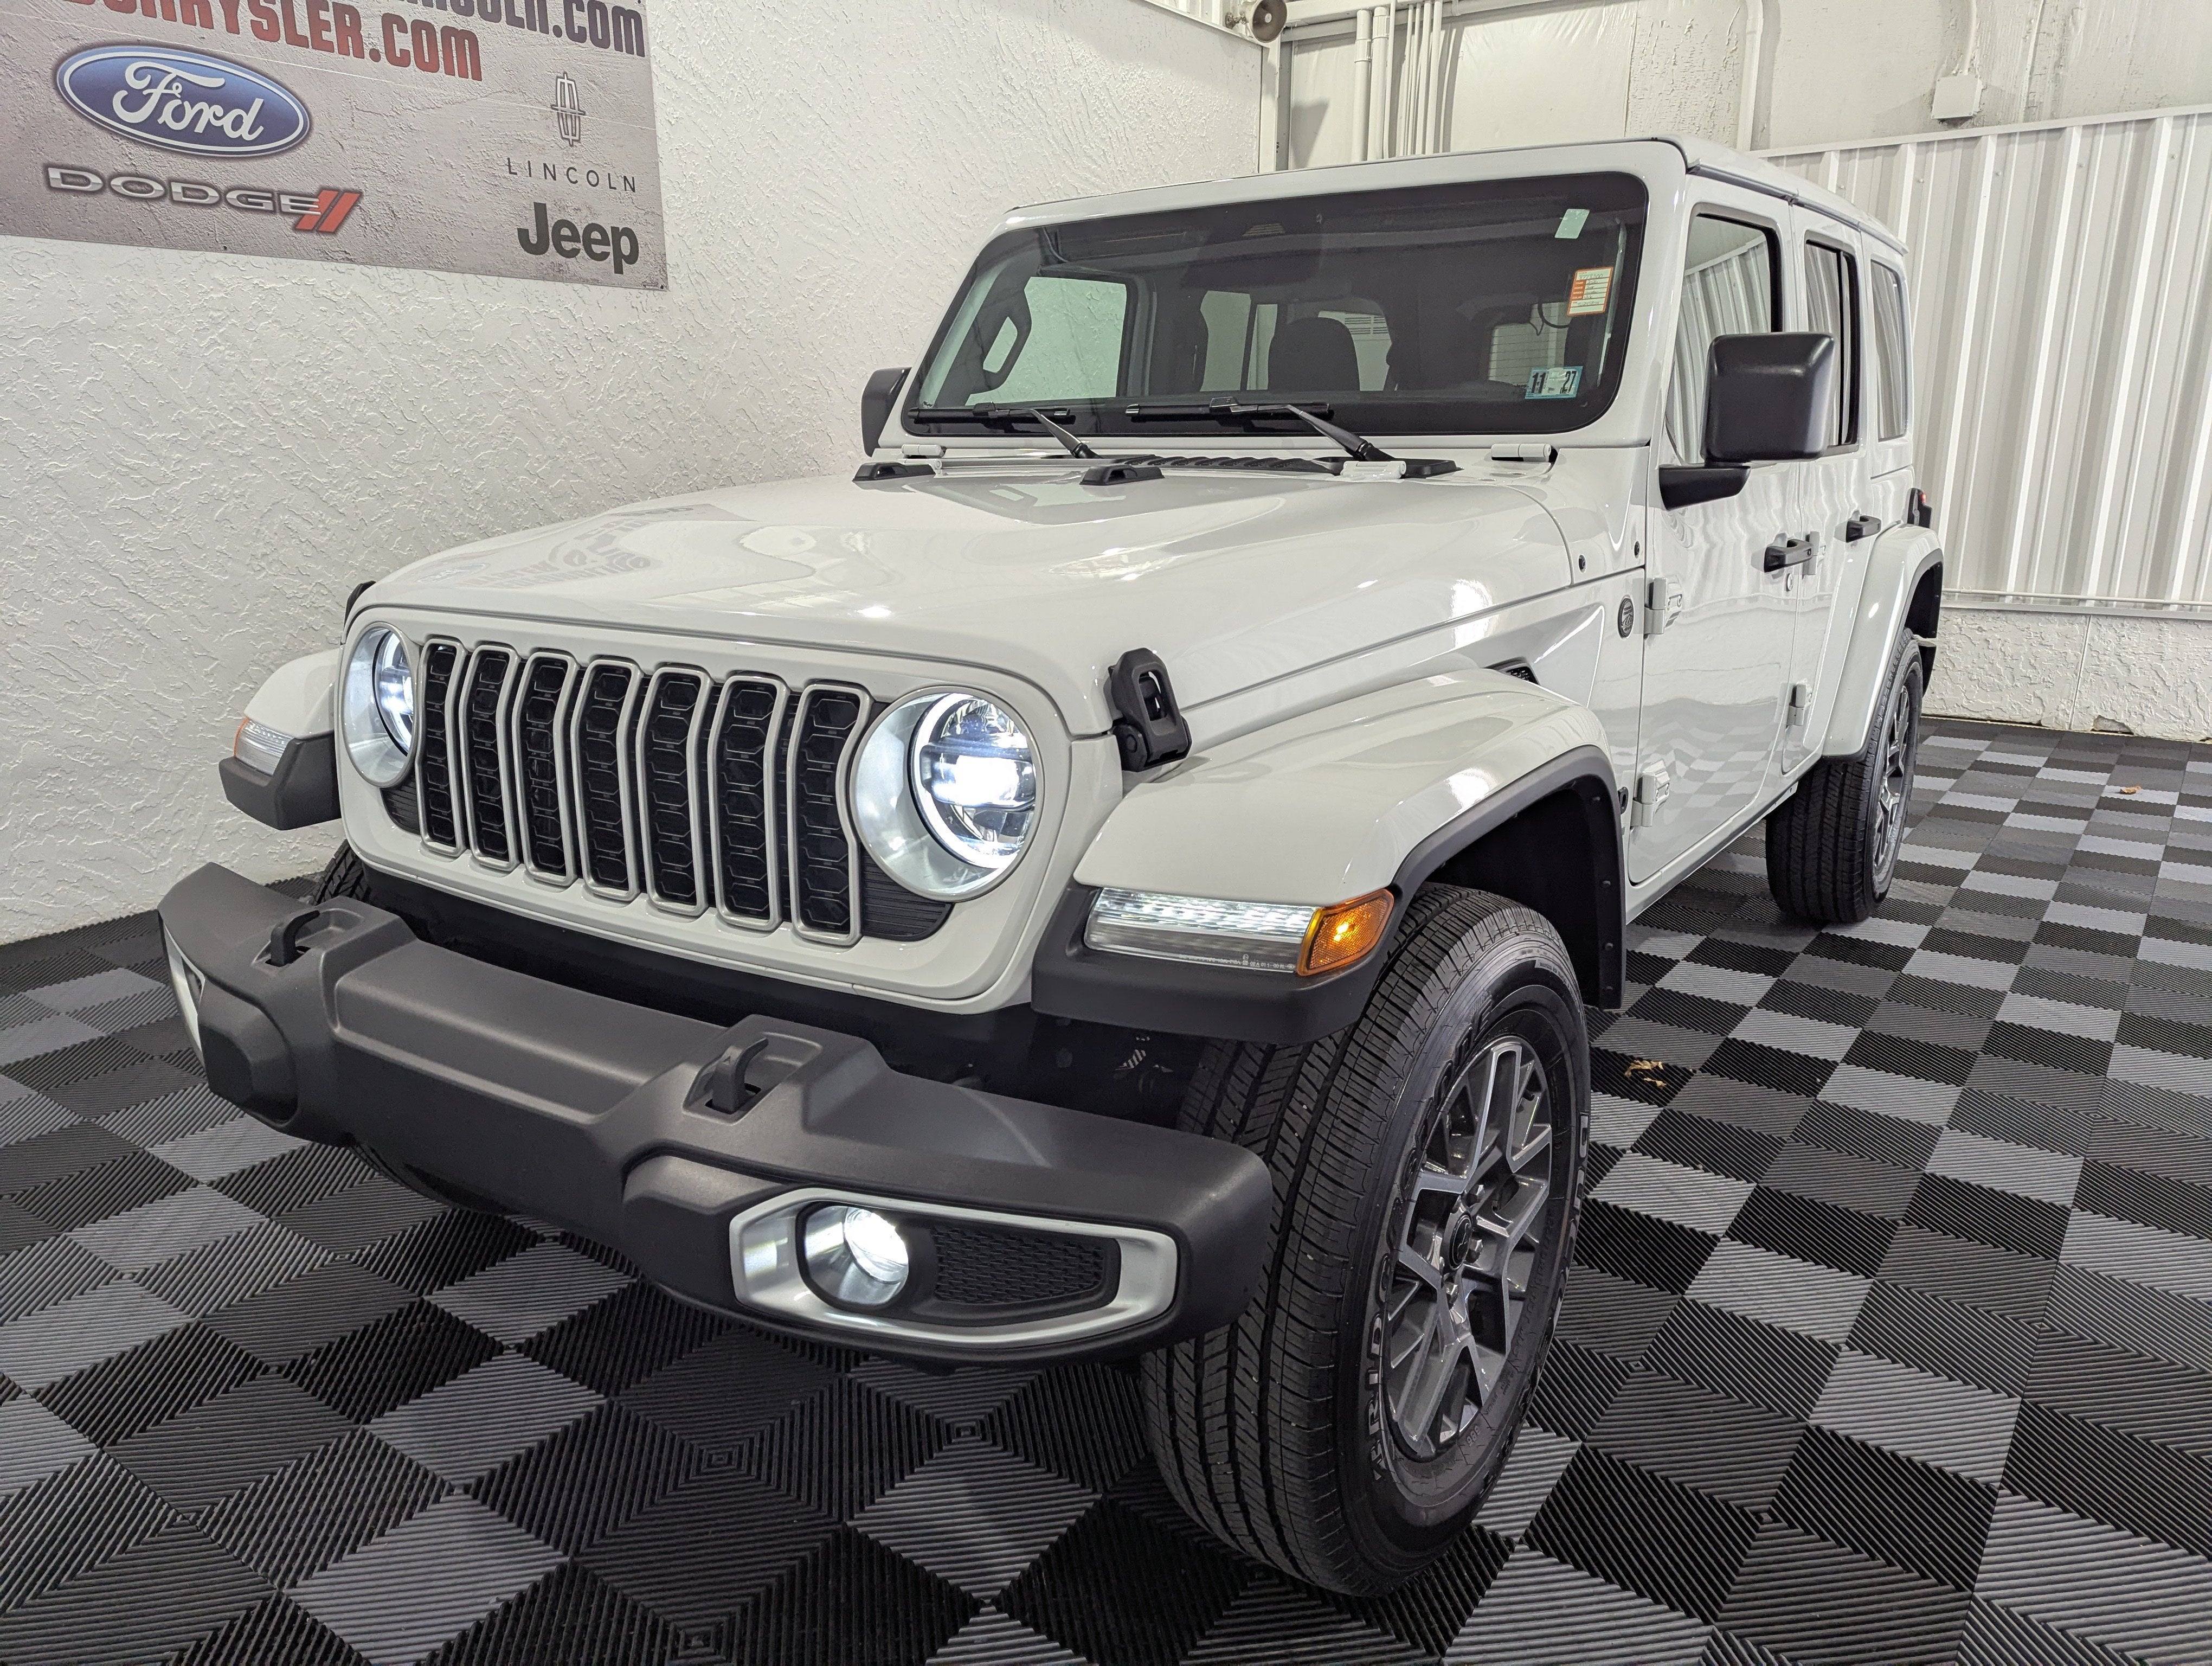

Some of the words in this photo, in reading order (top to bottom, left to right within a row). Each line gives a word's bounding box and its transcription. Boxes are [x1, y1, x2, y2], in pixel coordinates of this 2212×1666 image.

[112, 61, 264, 140] Ford
[47, 167, 321, 215] DODGE
[507, 157, 636, 193] LINCOLN
[517, 201, 639, 275] Jeep
[1531, 372, 1546, 394] 11
[1559, 370, 1577, 394] 27
